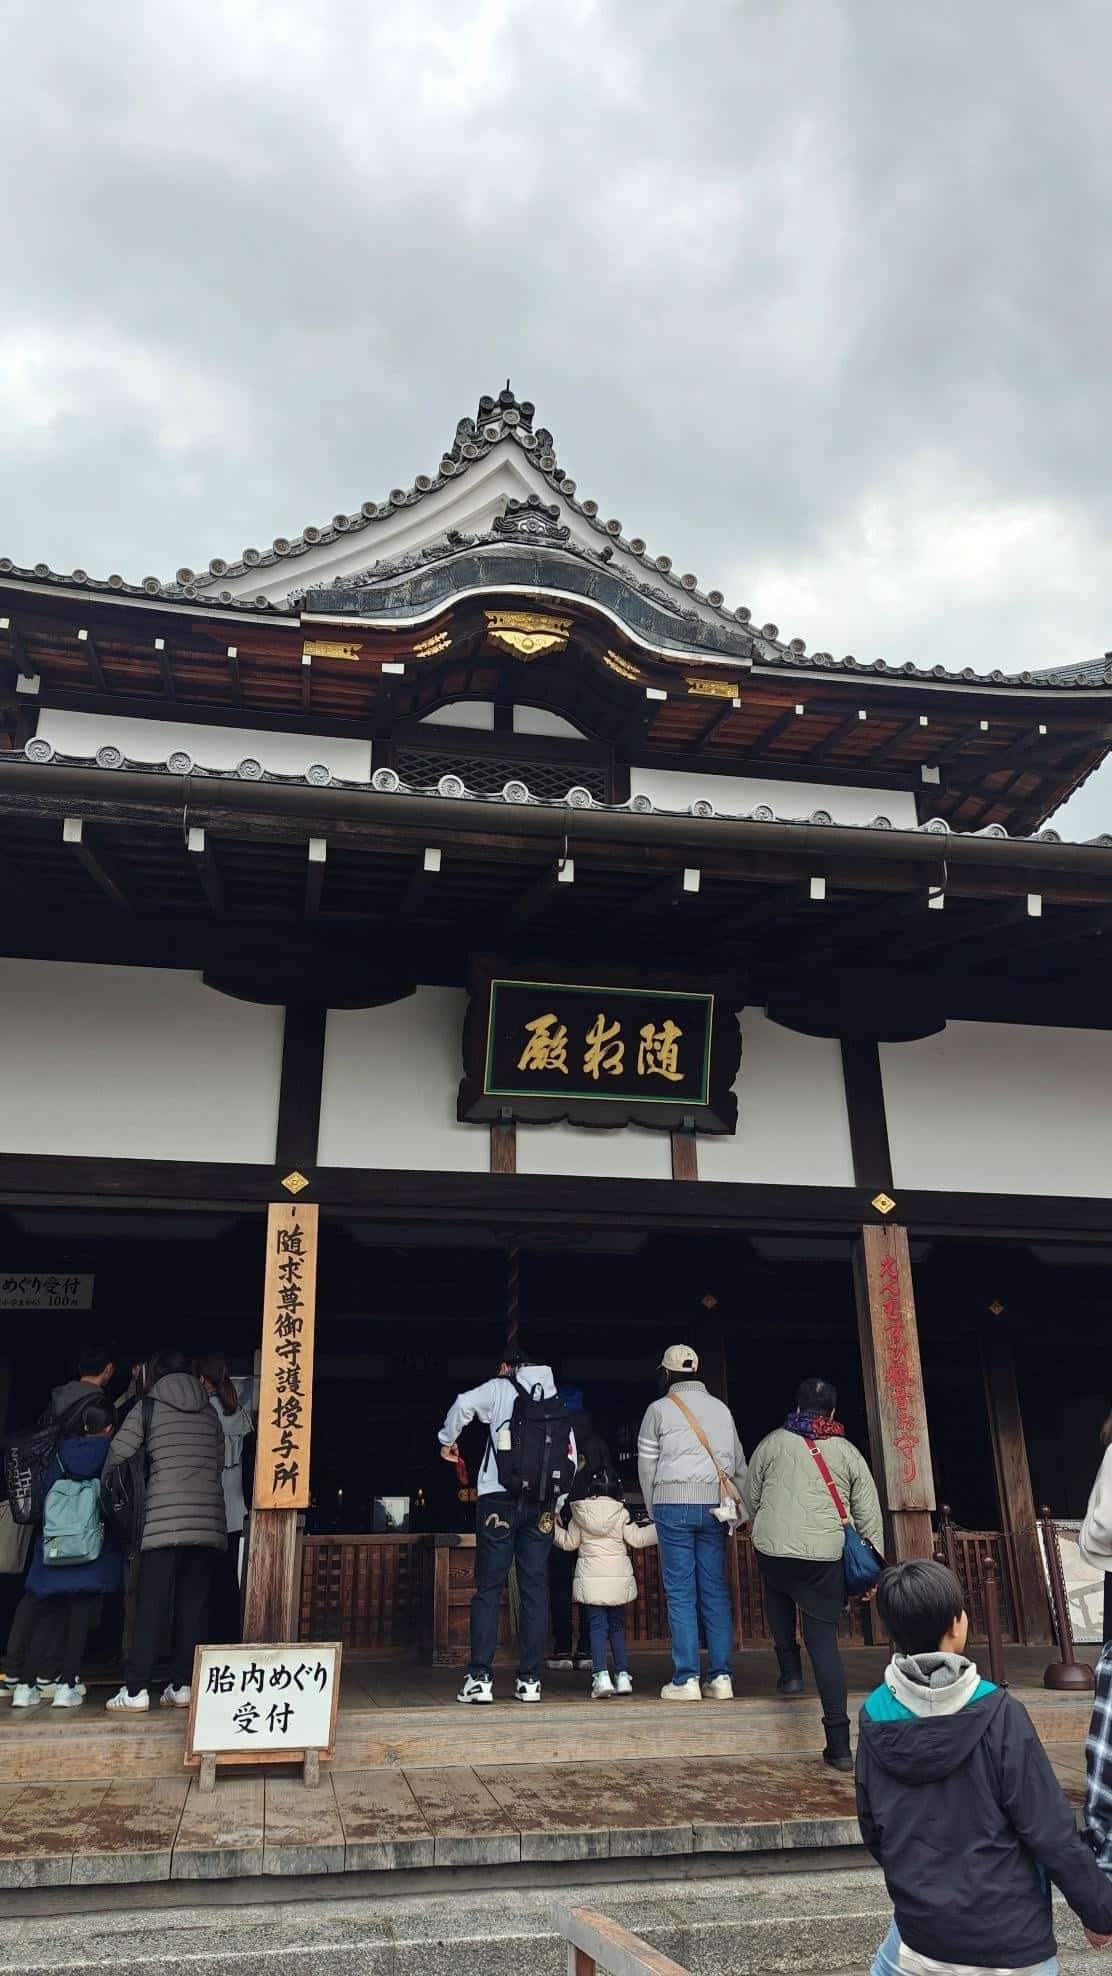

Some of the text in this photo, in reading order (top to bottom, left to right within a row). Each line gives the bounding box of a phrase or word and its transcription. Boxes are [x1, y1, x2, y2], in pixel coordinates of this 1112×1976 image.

[270, 1223, 308, 1496] 随求尊御守護授与所
[205, 1661, 328, 1695] 胎内めぐり
[232, 1701, 295, 1734] 受付
